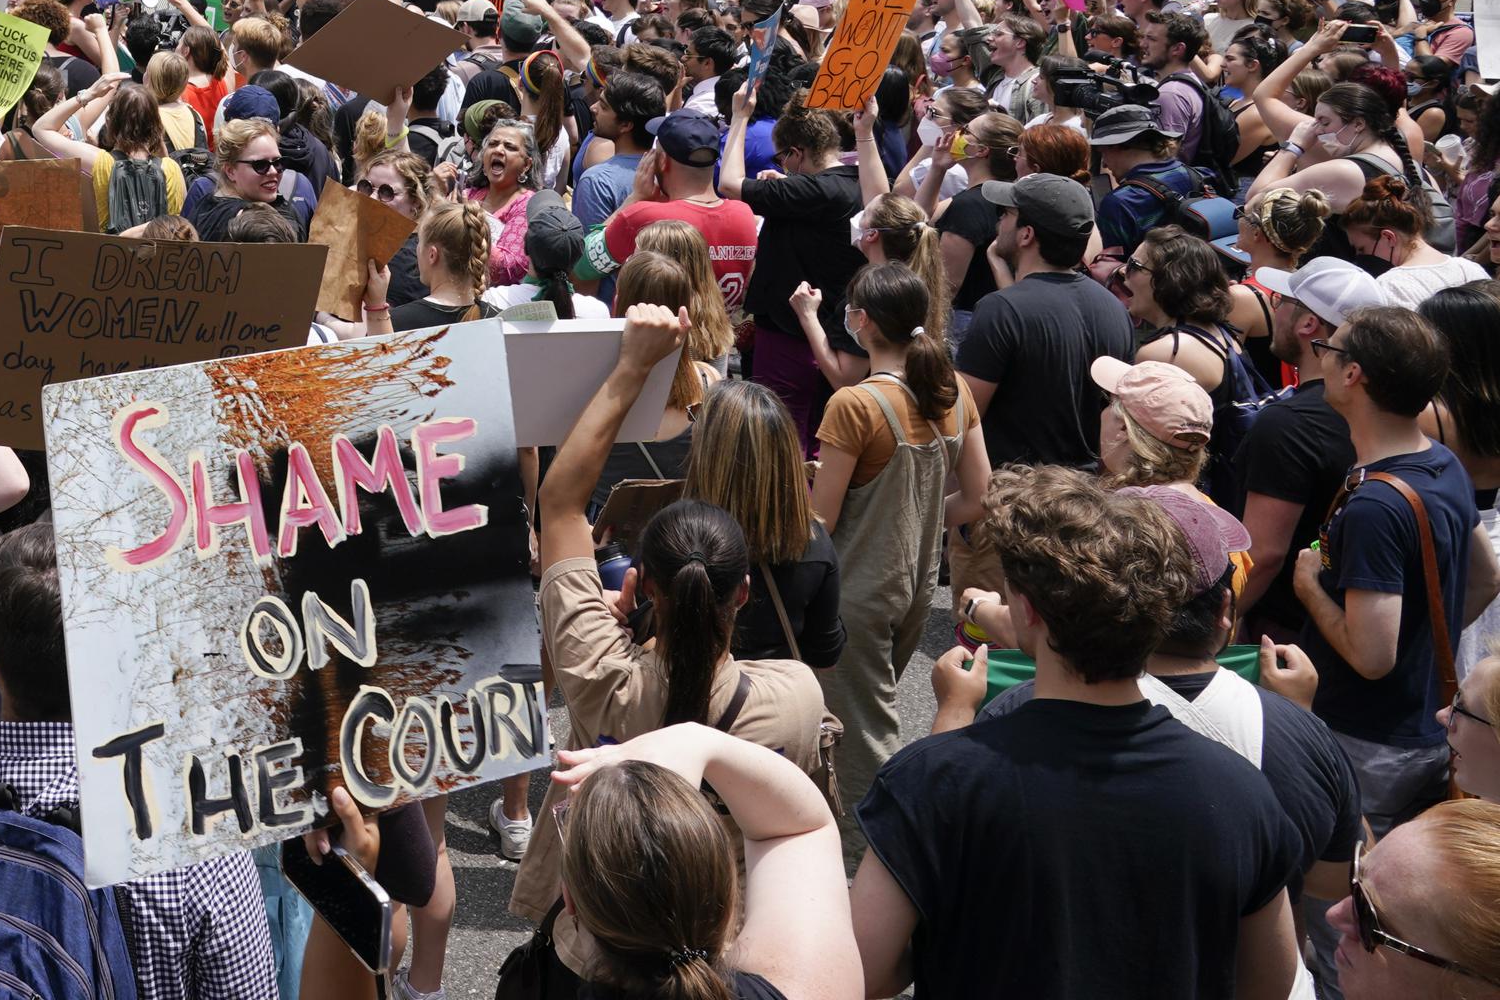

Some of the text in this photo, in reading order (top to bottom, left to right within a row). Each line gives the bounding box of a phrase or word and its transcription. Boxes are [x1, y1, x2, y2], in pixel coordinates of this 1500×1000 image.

[839, 10, 910, 50] WONT
[827, 47, 879, 79] GO
[807, 73, 881, 109] BACK
[10, 238, 242, 294] I DREAM
[717, 272, 745, 308] 2
[19, 289, 281, 344] WOMEN will one
[3, 341, 55, 387] day
[104, 401, 490, 573] SHAME
[241, 578, 378, 680] ON
[92, 662, 550, 841] THE COURT
